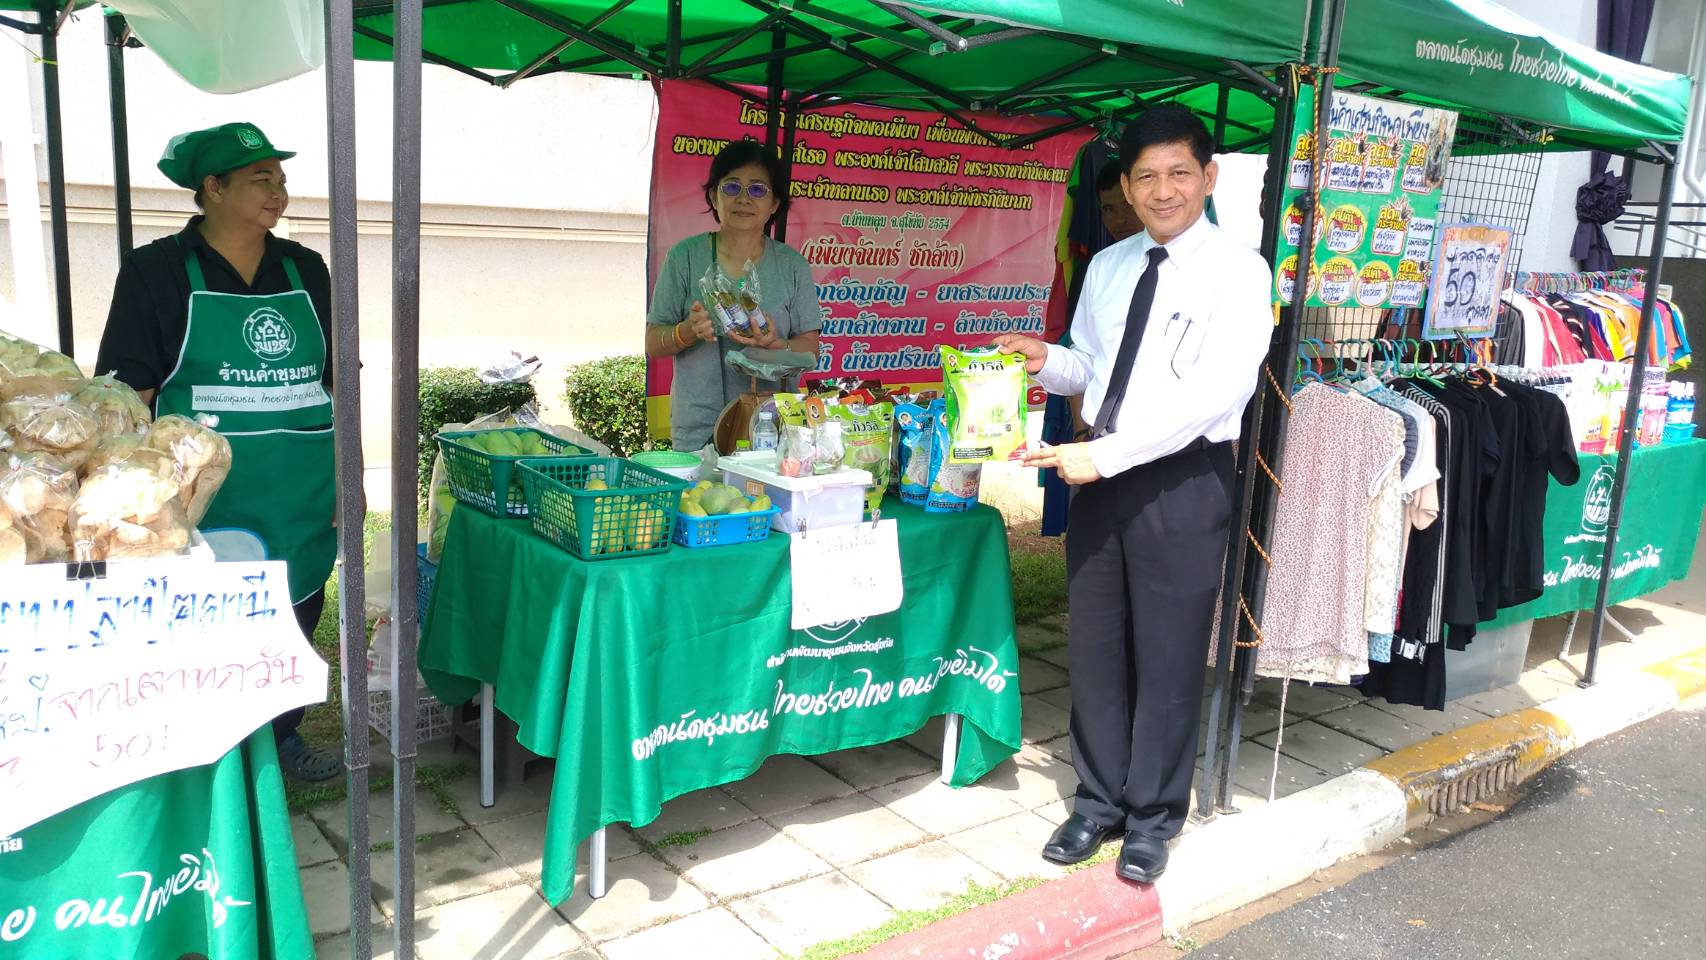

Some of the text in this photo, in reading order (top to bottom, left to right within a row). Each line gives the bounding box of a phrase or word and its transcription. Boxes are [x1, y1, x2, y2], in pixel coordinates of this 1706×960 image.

[928, 218, 950, 230] 2554
[1444, 268, 1477, 307] 50
[219, 361, 317, 389] ร้านค้าชุมชน
[772, 668, 894, 717] ไทยช่วยไทย
